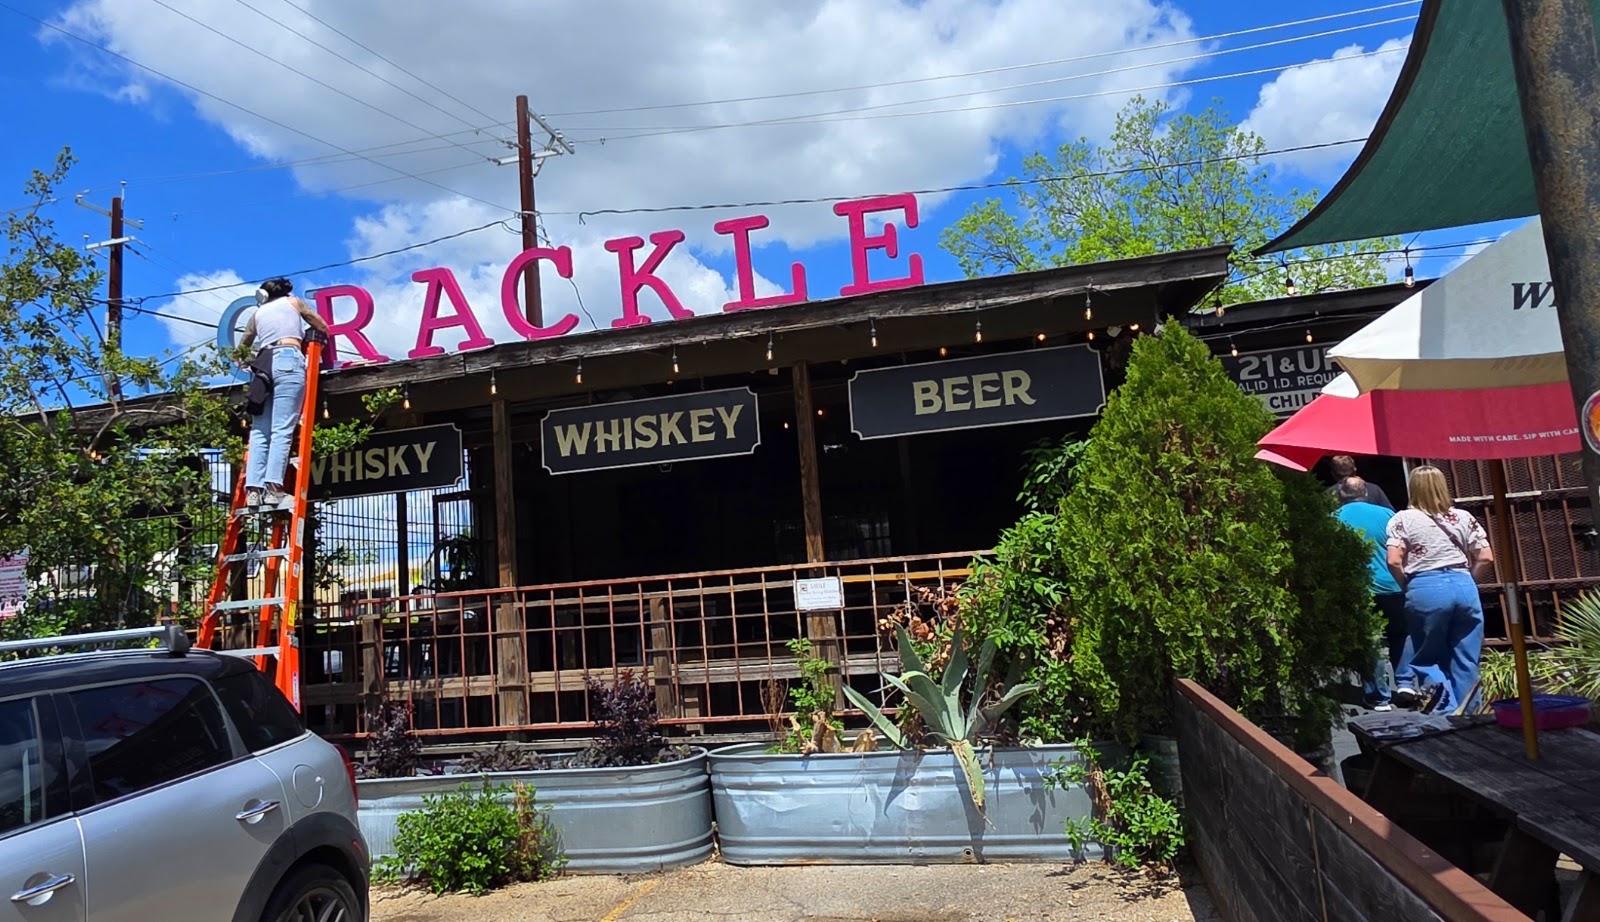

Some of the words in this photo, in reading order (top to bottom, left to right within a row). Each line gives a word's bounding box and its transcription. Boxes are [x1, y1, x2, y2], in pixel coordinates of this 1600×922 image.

[1511, 281, 1557, 310] W
[912, 369, 1037, 416] BEER
[1238, 380, 1268, 393] ALID
[554, 404, 744, 457] WHISKEY
[1539, 430, 1561, 438] WITH
